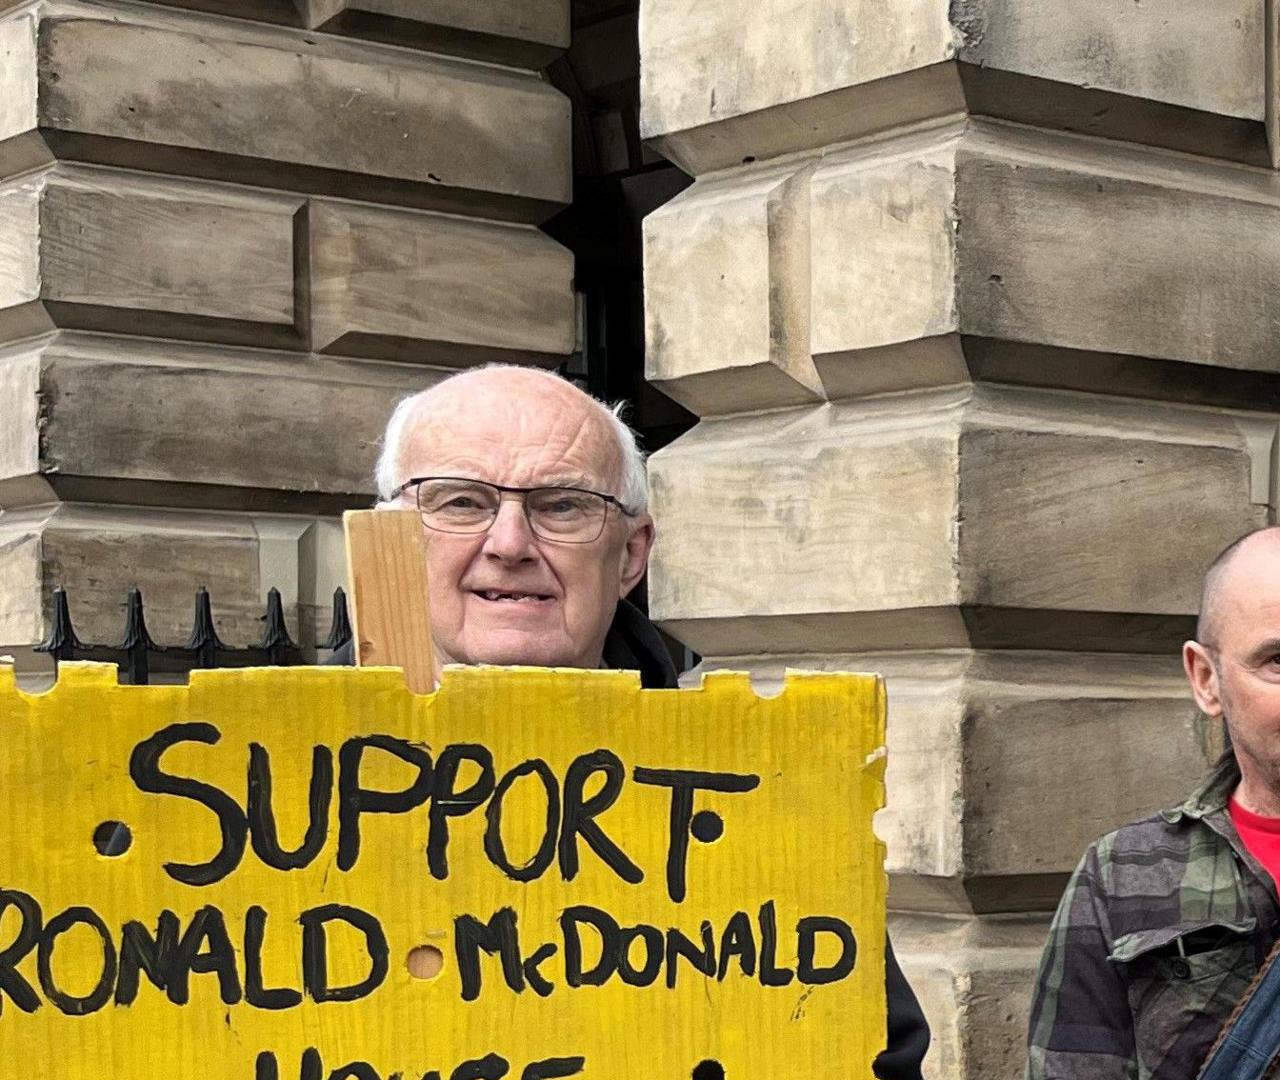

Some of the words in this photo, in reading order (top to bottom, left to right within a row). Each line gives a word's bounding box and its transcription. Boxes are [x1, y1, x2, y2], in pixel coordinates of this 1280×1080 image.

[128, 721, 760, 904] SUPPORT
[0, 888, 390, 1016] RONALD
[456, 898, 859, 1001] McDONALD
